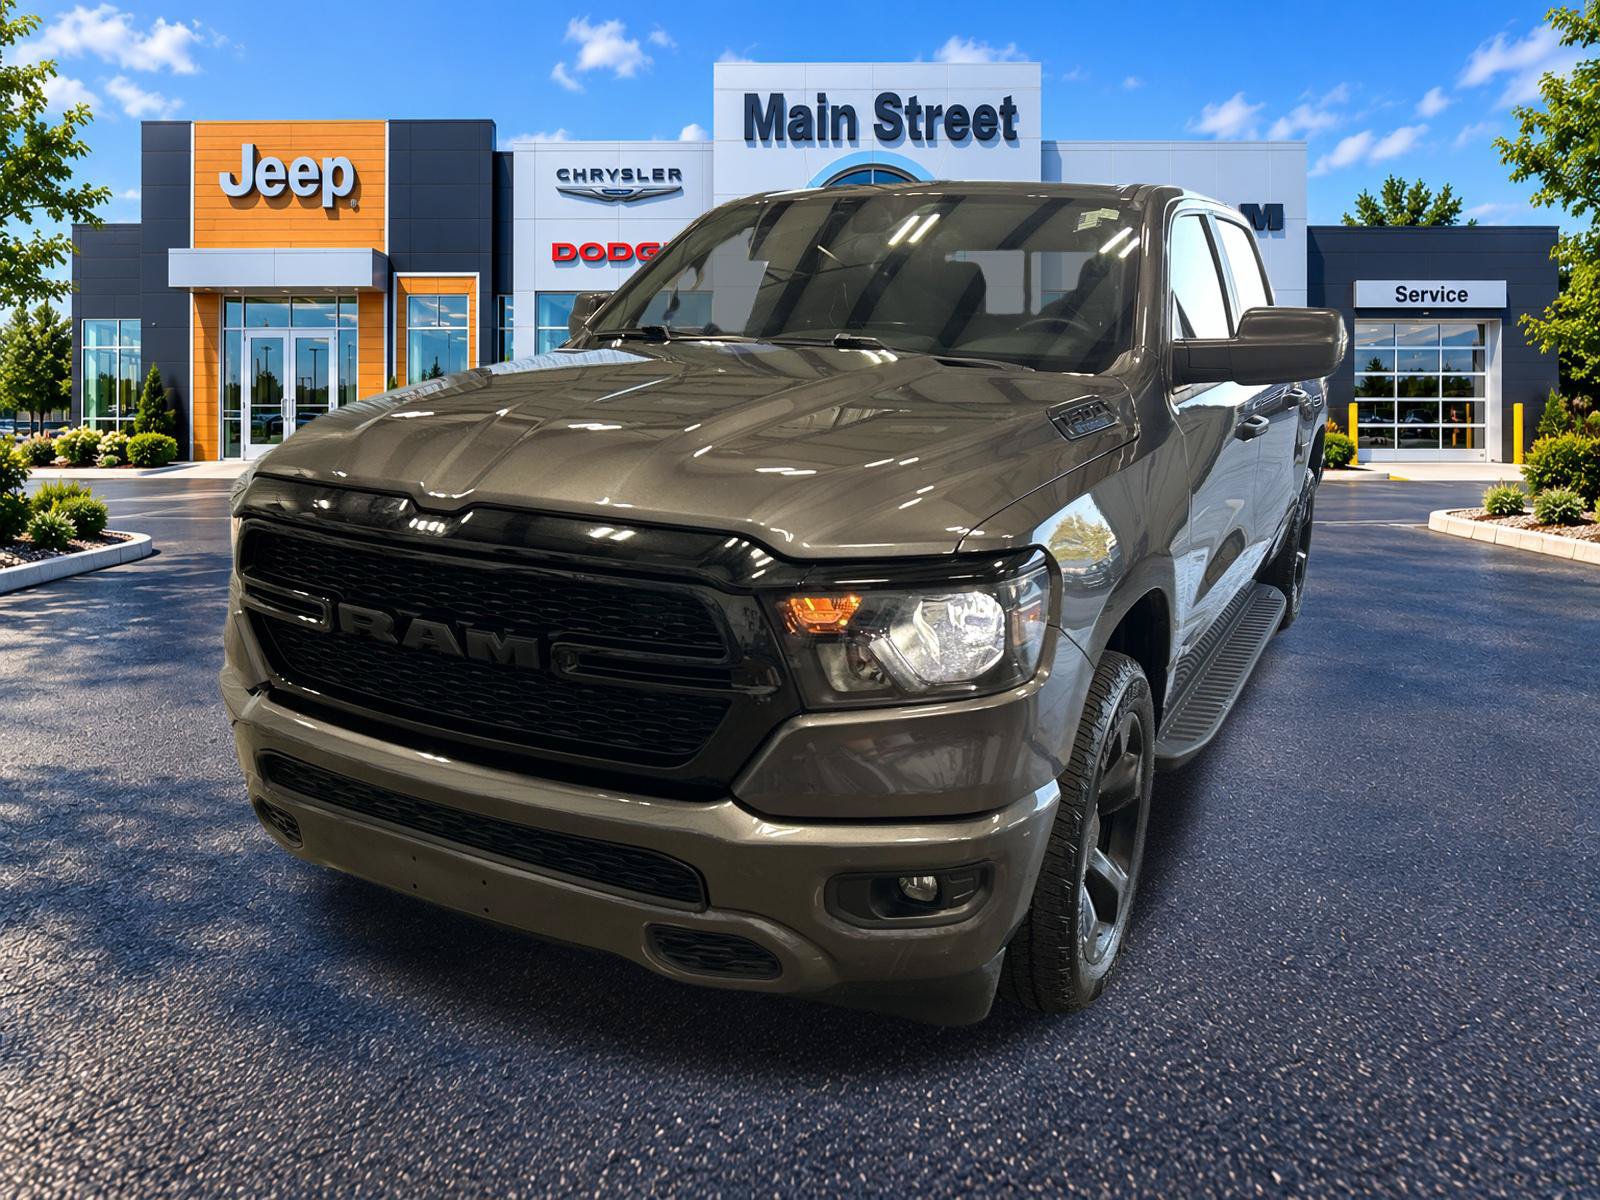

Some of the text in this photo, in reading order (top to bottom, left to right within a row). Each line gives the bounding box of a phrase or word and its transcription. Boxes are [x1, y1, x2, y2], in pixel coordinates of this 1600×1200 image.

[744, 91, 1017, 141] Main Street
[218, 143, 354, 208] Jeep
[556, 168, 683, 182] CHRYSLER
[552, 241, 670, 262] DODG
[1395, 285, 1469, 303] Service
[338, 602, 540, 669] RAM
